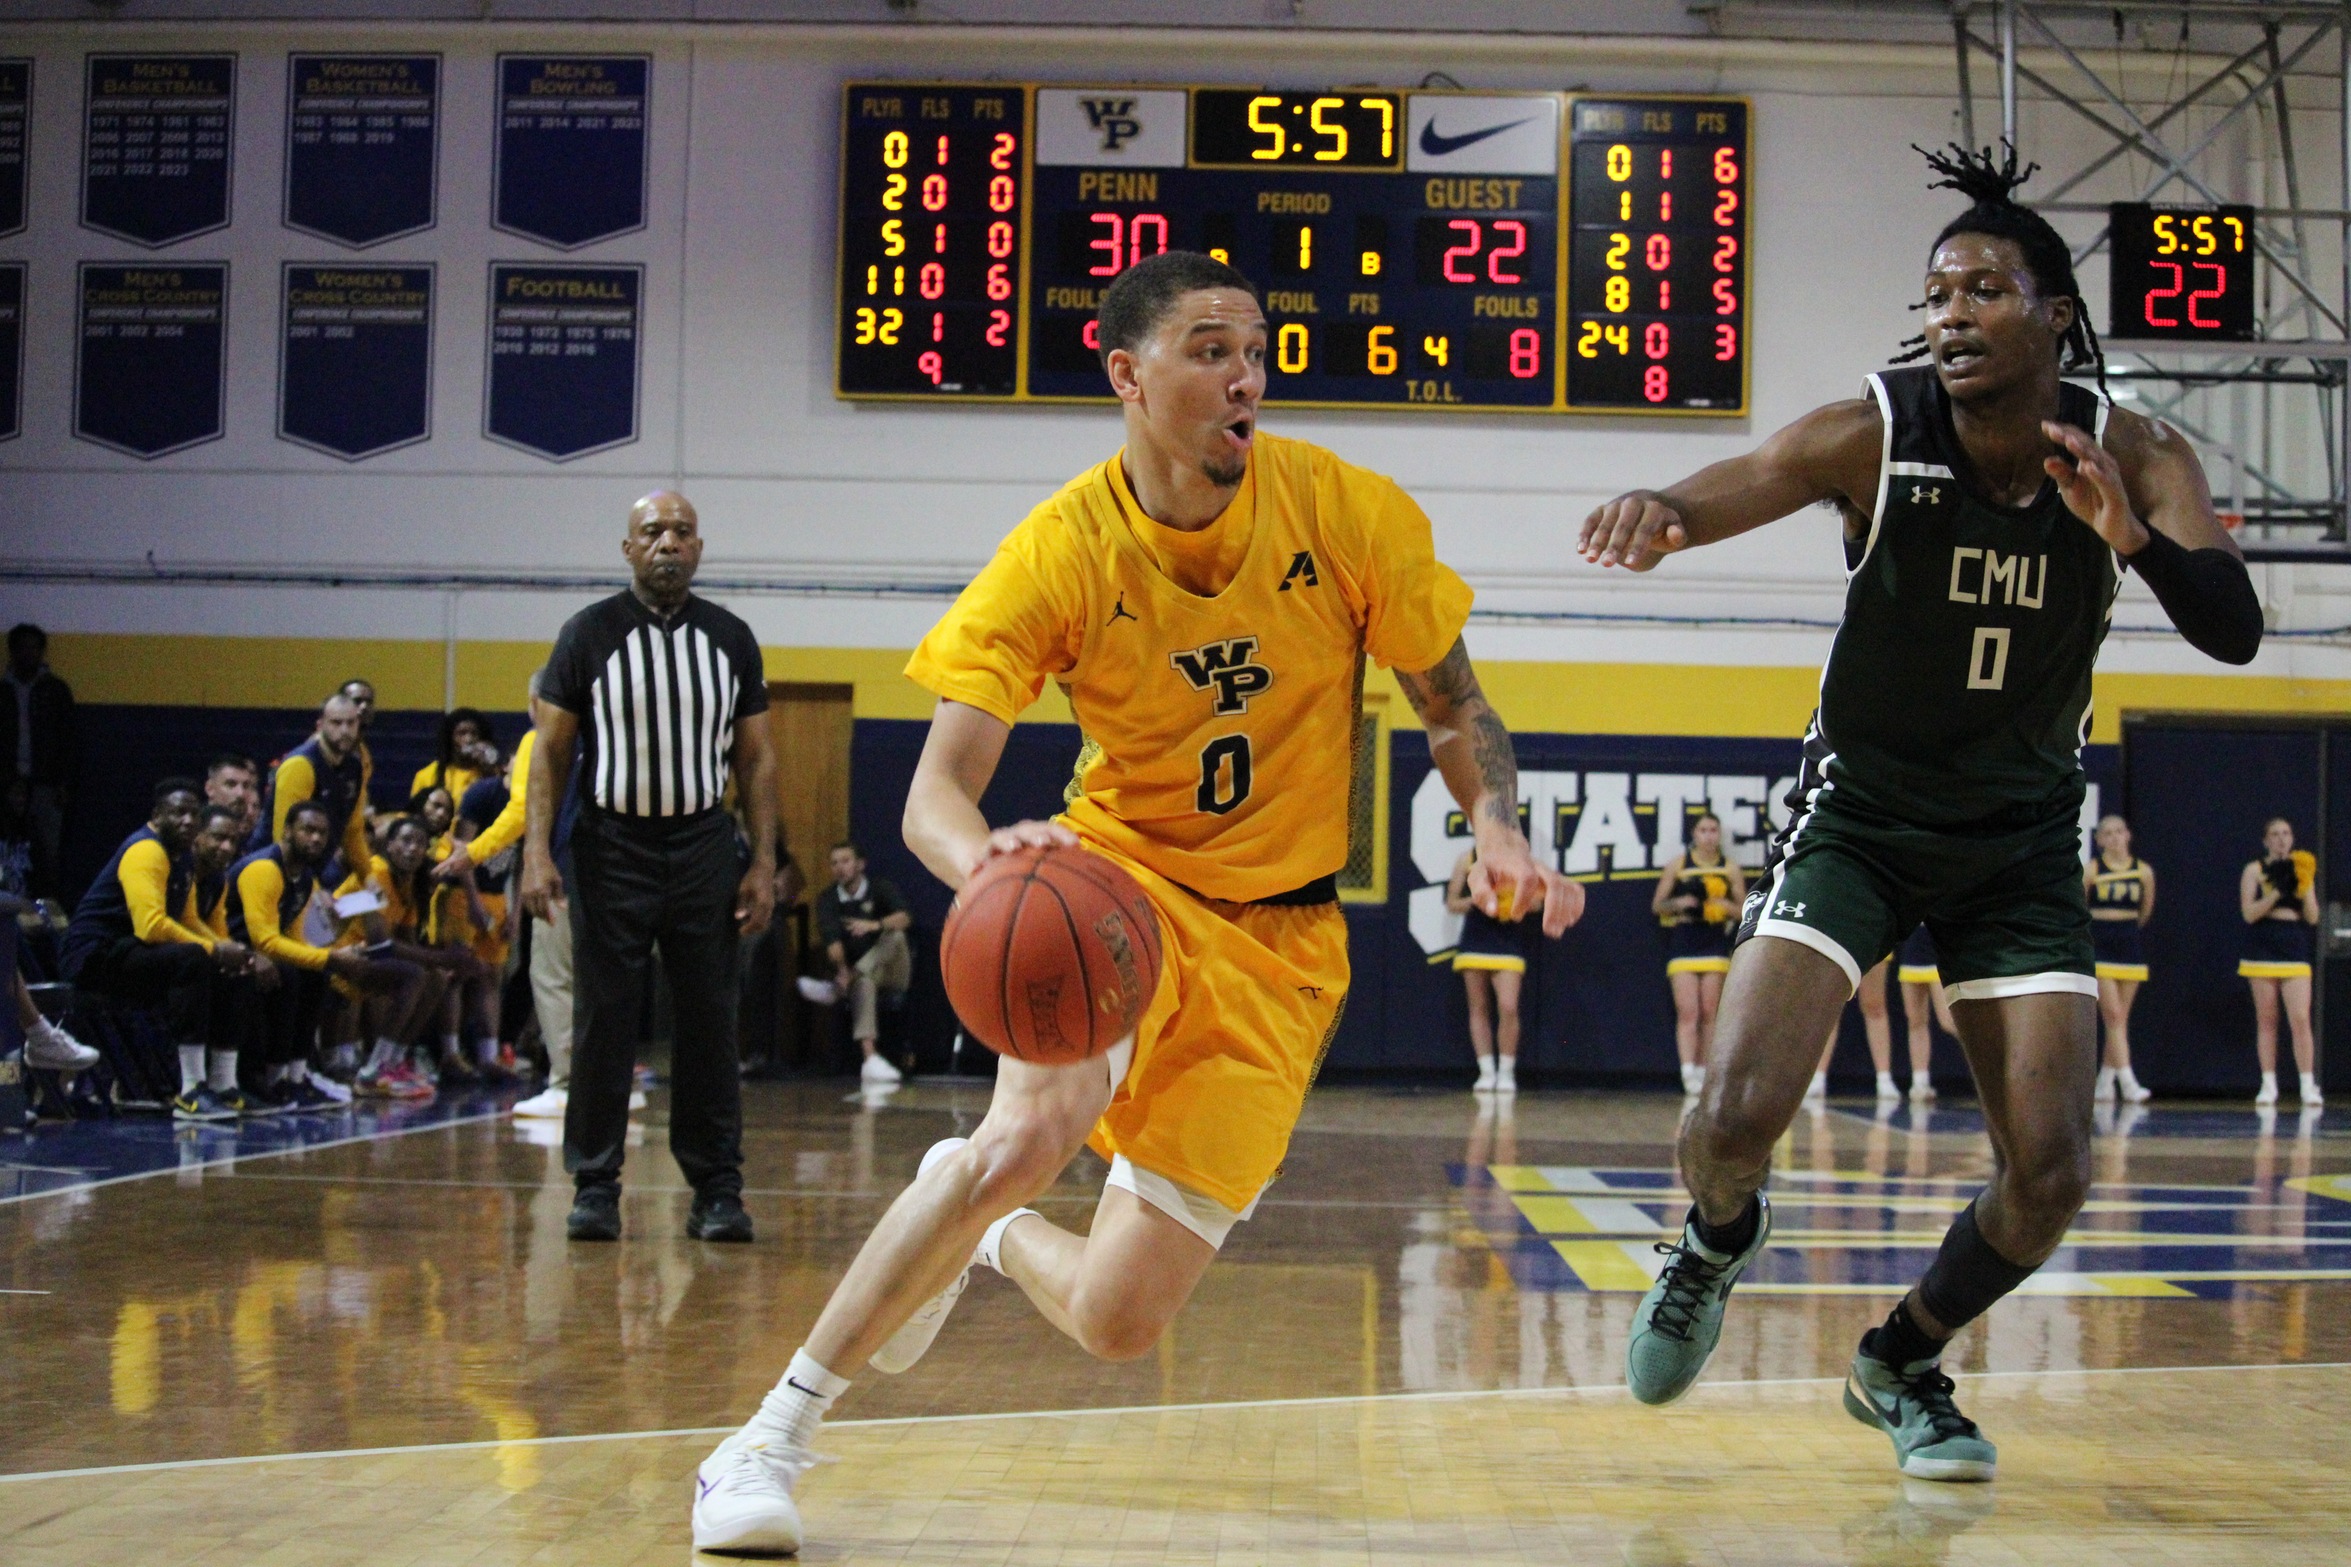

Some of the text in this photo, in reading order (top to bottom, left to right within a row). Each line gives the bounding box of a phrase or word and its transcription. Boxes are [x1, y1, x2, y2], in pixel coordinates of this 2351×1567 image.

[103, 79, 217, 93] BASKETBALL
[133, 63, 190, 77] MEN'S
[306, 78, 422, 93] BASKETBALL
[321, 63, 409, 78] WOMEN'S
[530, 78, 617, 94] BOWLING
[544, 63, 604, 78] MEN'S
[921, 98, 948, 118] FLS
[973, 98, 1004, 119] PTS
[1643, 111, 1672, 132] FLS
[1696, 112, 1727, 134] PTS
[1248, 97, 1393, 160] 5:57
[884, 131, 1015, 170] 0 1 2
[1607, 144, 1738, 184] 0 1 6
[883, 174, 1014, 212] 2 0 0
[1078, 173, 1159, 201] PENN
[1257, 192, 1332, 214] PERIOD
[1425, 178, 1523, 211] GUEST
[1620, 190, 1738, 226] 1 1 2
[882, 219, 1013, 258] 5 1 0
[1090, 213, 1168, 276] 30
[1300, 227, 1311, 269] 1
[1444, 220, 1526, 284] 22
[1606, 233, 1737, 272] 2 0 2
[2154, 215, 2243, 255] 5:57
[124, 272, 182, 287] MEN'S
[143, 289, 220, 303] COUNTRY
[315, 272, 404, 288] WOMEN'S
[348, 288, 426, 303] COUNTRY
[506, 276, 625, 298] FOOTBALL
[867, 262, 1011, 300] 11 0 6
[1605, 276, 1736, 315] 8 1 5
[2145, 261, 2226, 327] 22
[1267, 291, 1380, 315] FOUL PTS
[1474, 296, 1539, 318] FOULS
[856, 308, 1010, 346] 32 1 2
[1578, 321, 1736, 360] 24 0 3
[1278, 324, 1308, 373] 0
[1368, 326, 1397, 374] 6
[1424, 336, 1448, 366] 4
[1510, 329, 1540, 378] 8
[918, 351, 942, 384] 9
[1644, 365, 1668, 402] 8
[1948, 546, 2047, 610] CMU
[1169, 635, 1274, 717] WP
[1966, 627, 2011, 691] 0
[1195, 732, 1252, 817] 0
